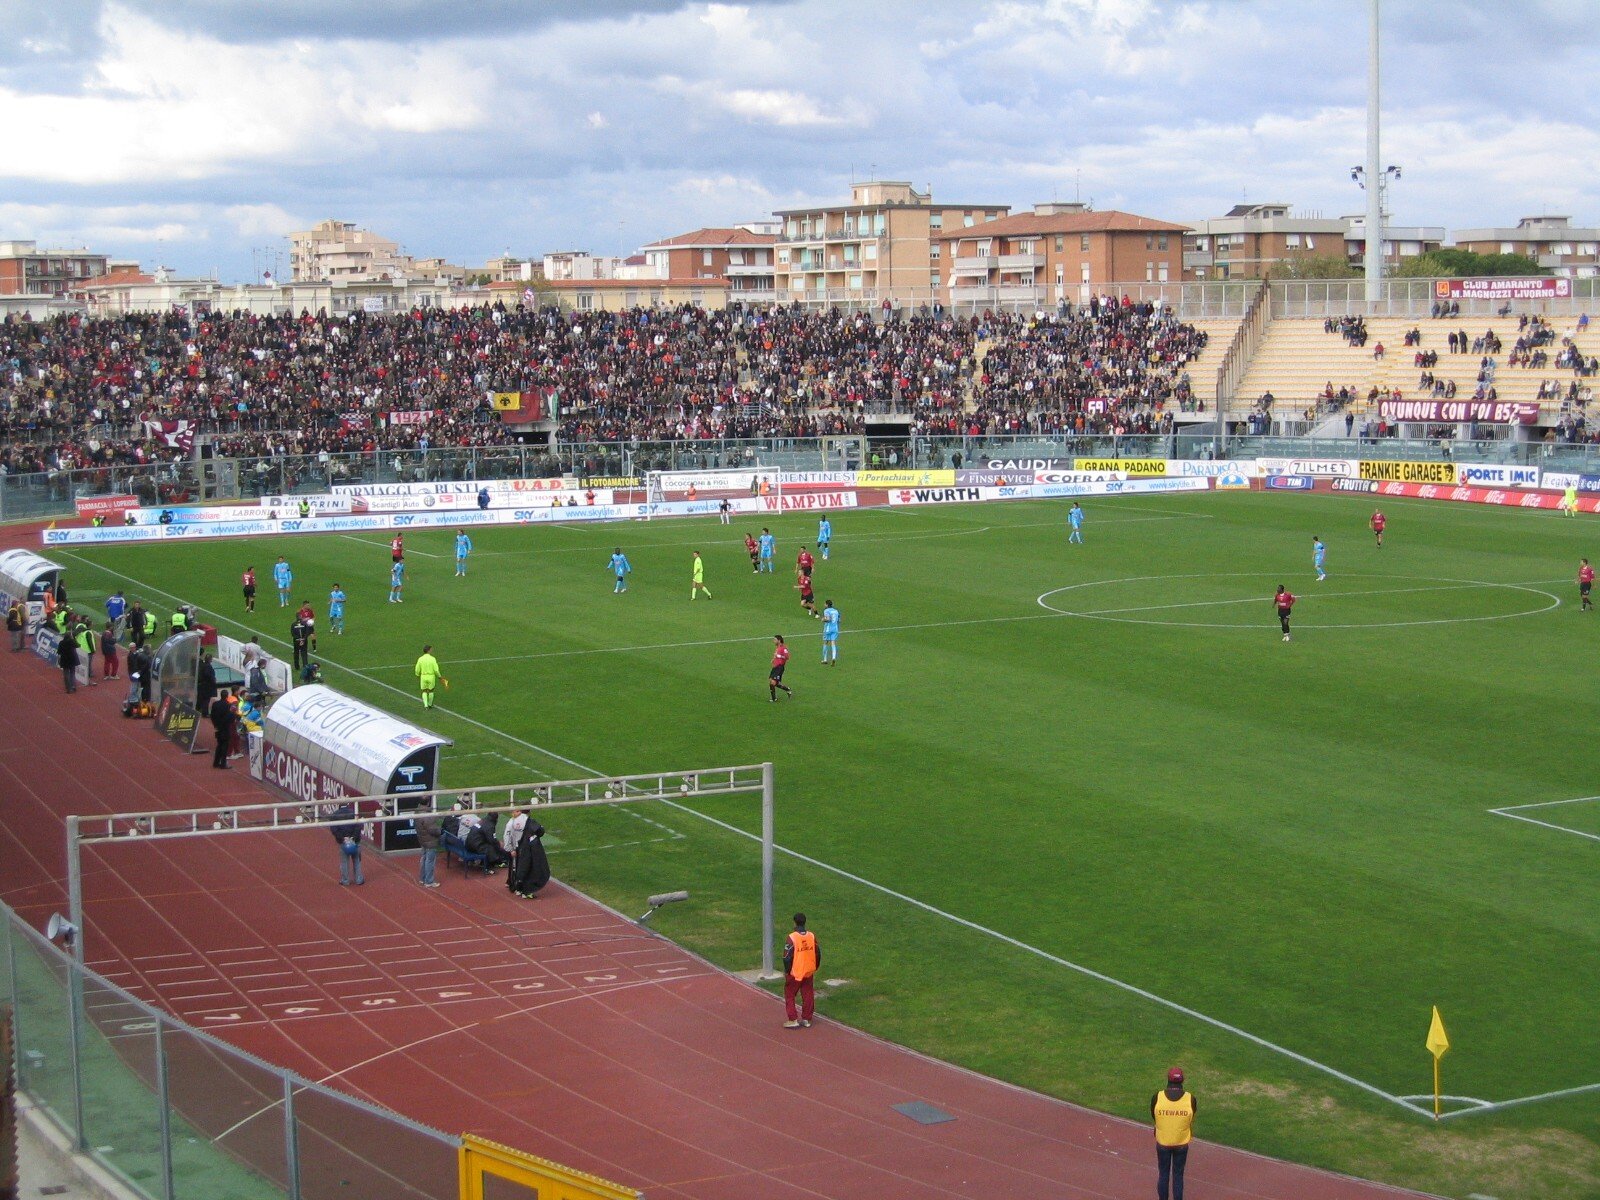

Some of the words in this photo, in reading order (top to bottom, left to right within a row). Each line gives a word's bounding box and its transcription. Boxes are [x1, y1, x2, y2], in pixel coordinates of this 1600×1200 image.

[1463, 281, 1488, 289] CLUB
[1491, 280, 1543, 289] AMARANTO
[1514, 289, 1554, 298] LIVORNO
[1088, 400, 1103, 414] 69
[1381, 401, 1437, 420] OVUNQUE
[1442, 402, 1465, 420] CON
[395, 412, 431, 423] 1921
[1084, 462, 1120, 472] GRANA
[1124, 462, 1165, 473] PADANO
[1294, 462, 1347, 475] ZILMET
[1359, 462, 1401, 480] FRANKIE
[1403, 463, 1443, 481] GARAGE
[865, 473, 915, 481] Portachiavi
[969, 474, 1033, 484] FINSERVICE
[1045, 474, 1105, 483] COFRA
[1467, 468, 1504, 481] PORTE
[581, 479, 588, 487] IL
[589, 476, 640, 488] FOTOAMATORE
[1105, 482, 1124, 492] SKY
[1287, 478, 1302, 486] TIM
[334, 484, 412, 496] FORMAGGI
[999, 487, 1017, 497] SKY
[371, 501, 401, 509] Scardigli
[403, 500, 419, 508] Auto
[763, 488, 844, 510] WAMPUM
[78, 502, 107, 511] FARMACIA
[181, 512, 220, 520] Immobiliare
[393, 515, 415, 525] SKY
[436, 511, 495, 524] www.skylife.it
[514, 510, 535, 520] SKY
[565, 506, 623, 518] www.skylife.it
[281, 520, 303, 530] SKY
[325, 516, 385, 529] www.skylife.it
[47, 530, 71, 541] SKY
[93, 527, 158, 540] www.skylife.it
[165, 525, 188, 536] SKY
[211, 522, 273, 535] www.skylife.it
[277, 752, 318, 801] CARIGE
[322, 775, 345, 801] BANCA
[512, 982, 545, 990] 3
[362, 997, 397, 1006] 5
[284, 1006, 320, 1015] 6
[203, 1012, 242, 1021] 7
[1158, 1109, 1189, 1117] STEWARD
